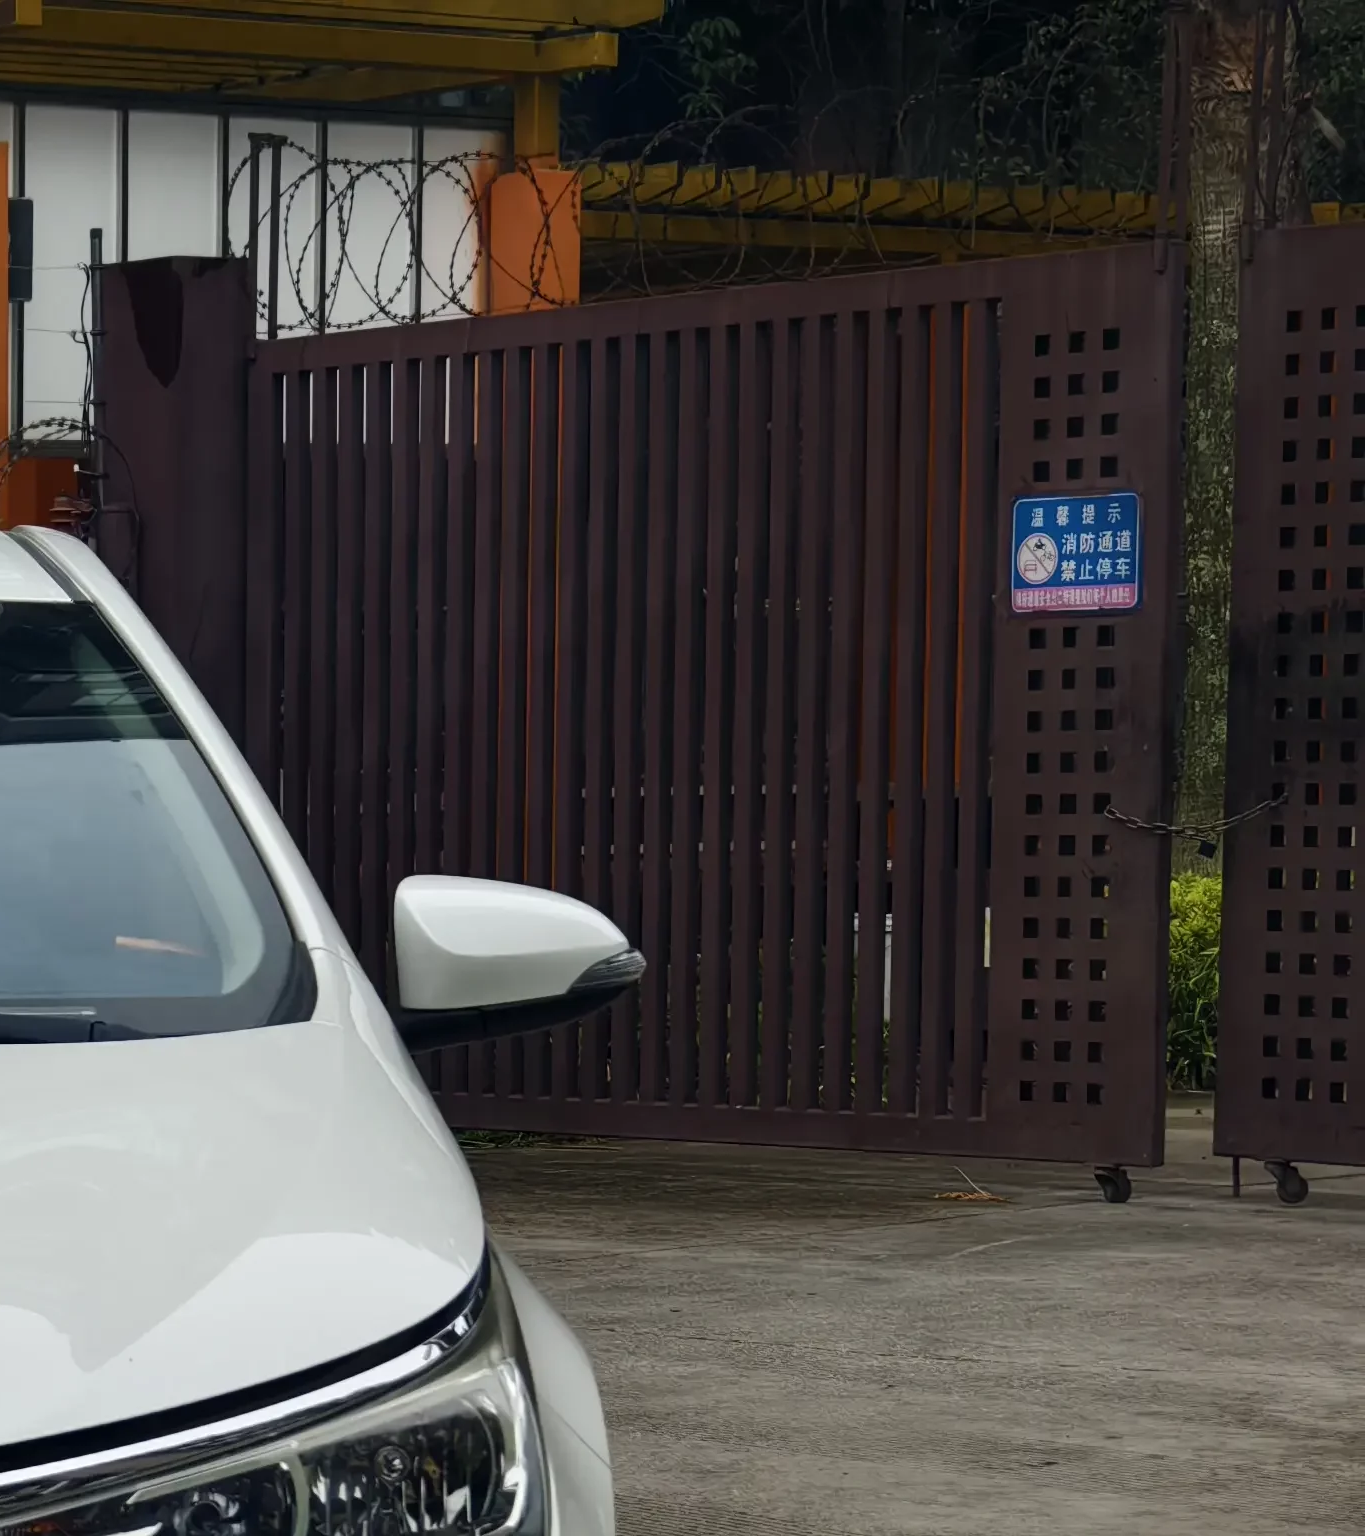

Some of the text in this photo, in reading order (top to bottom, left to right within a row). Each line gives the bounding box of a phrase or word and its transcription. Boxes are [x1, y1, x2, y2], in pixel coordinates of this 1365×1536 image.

[1030, 503, 1121, 528] 温馨提示
[1061, 529, 1132, 555] 消防通道
[1060, 558, 1131, 582] 禁止停车
